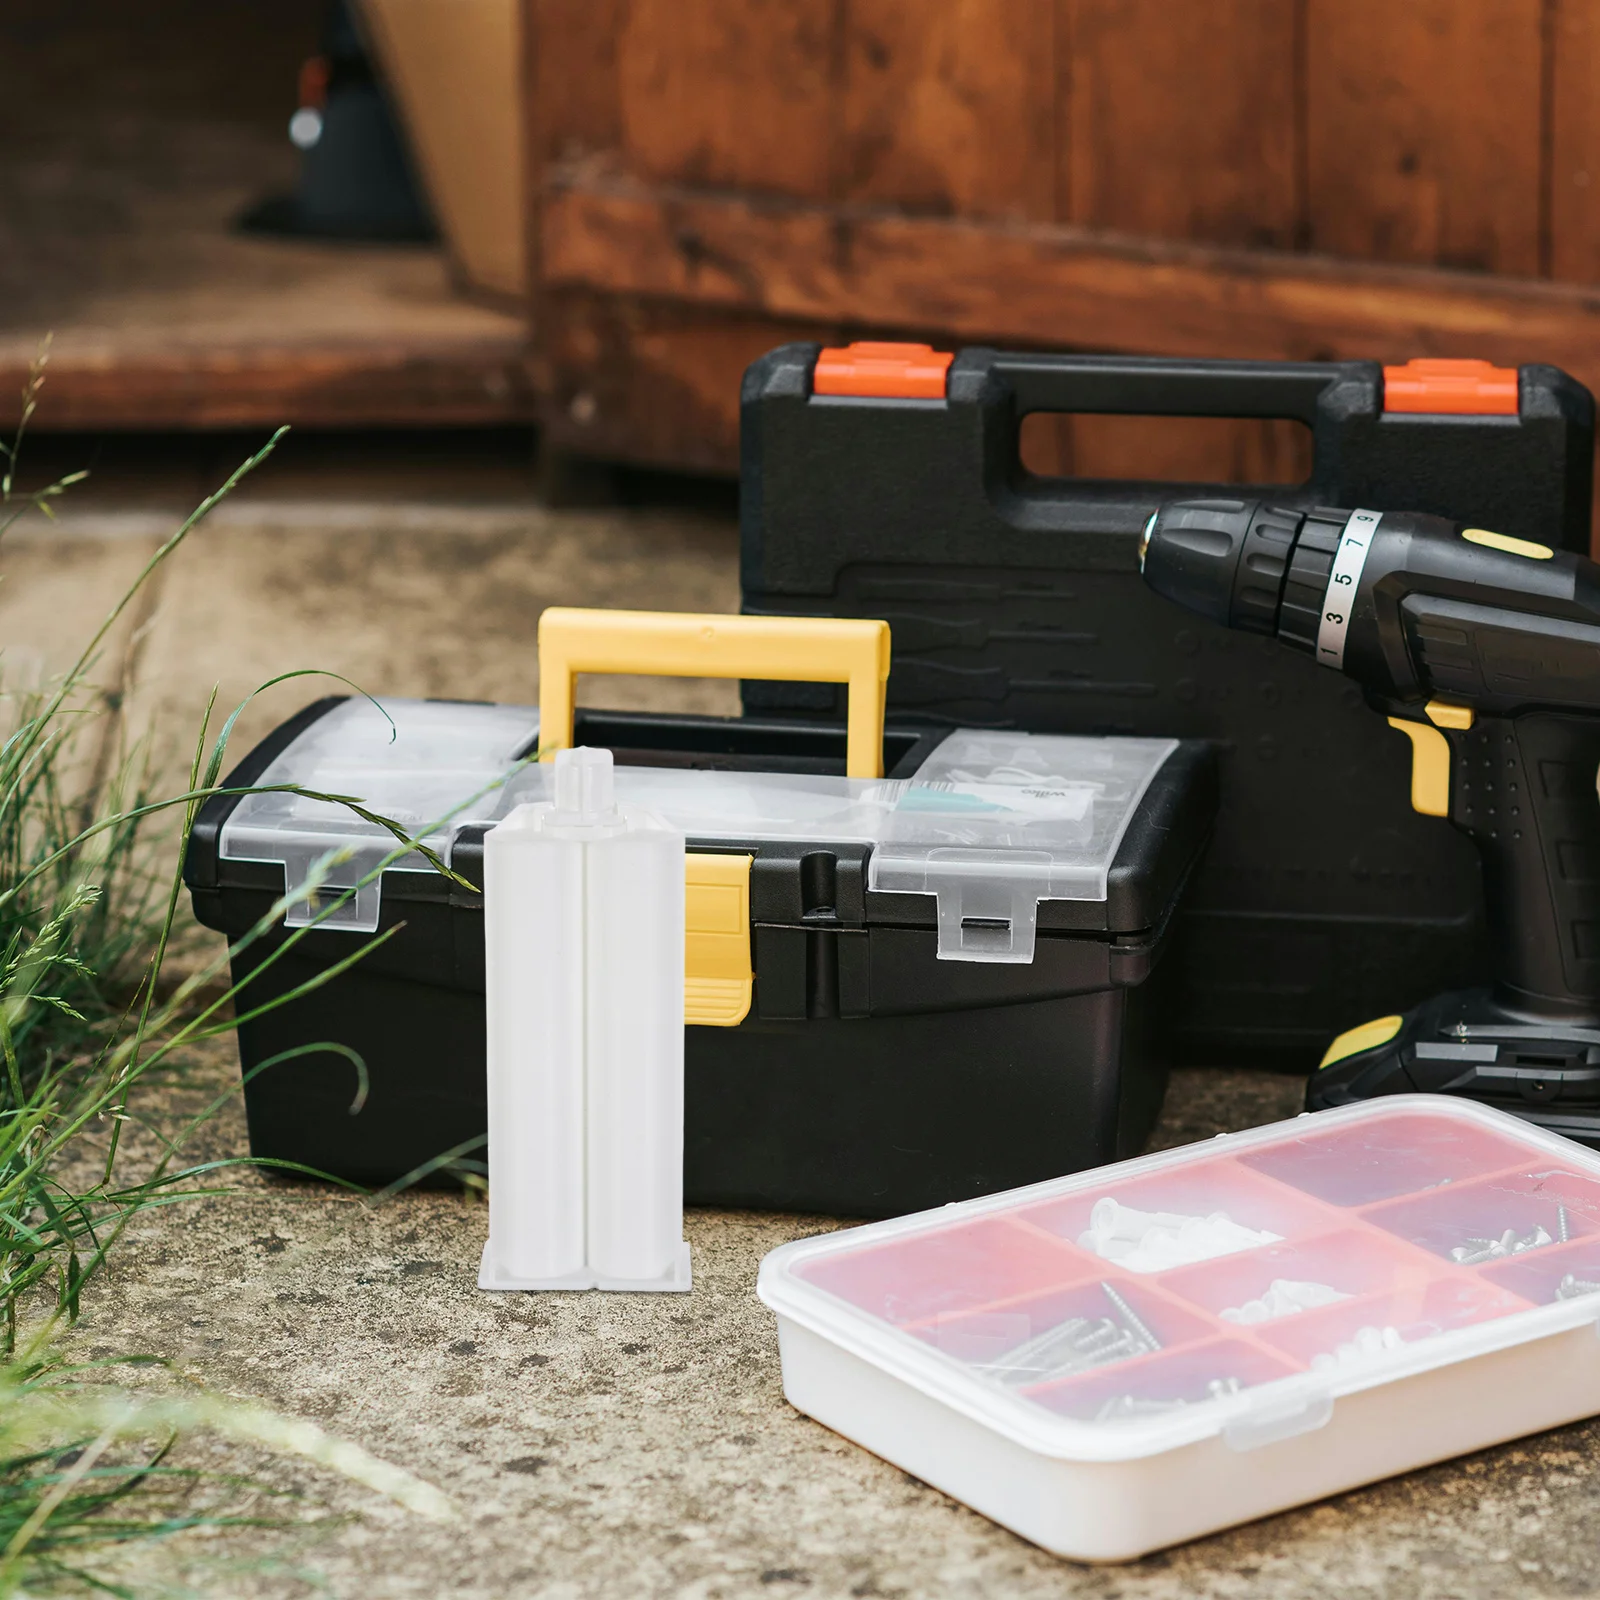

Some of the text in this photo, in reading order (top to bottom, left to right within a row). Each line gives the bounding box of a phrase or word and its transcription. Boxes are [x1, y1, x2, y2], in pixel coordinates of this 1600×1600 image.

[1345, 538, 1364, 547] 7
[1334, 572, 1353, 586] 5
[1325, 612, 1344, 625] 3
[1320, 647, 1338, 656] 1
[1021, 789, 1067, 799] wilko
